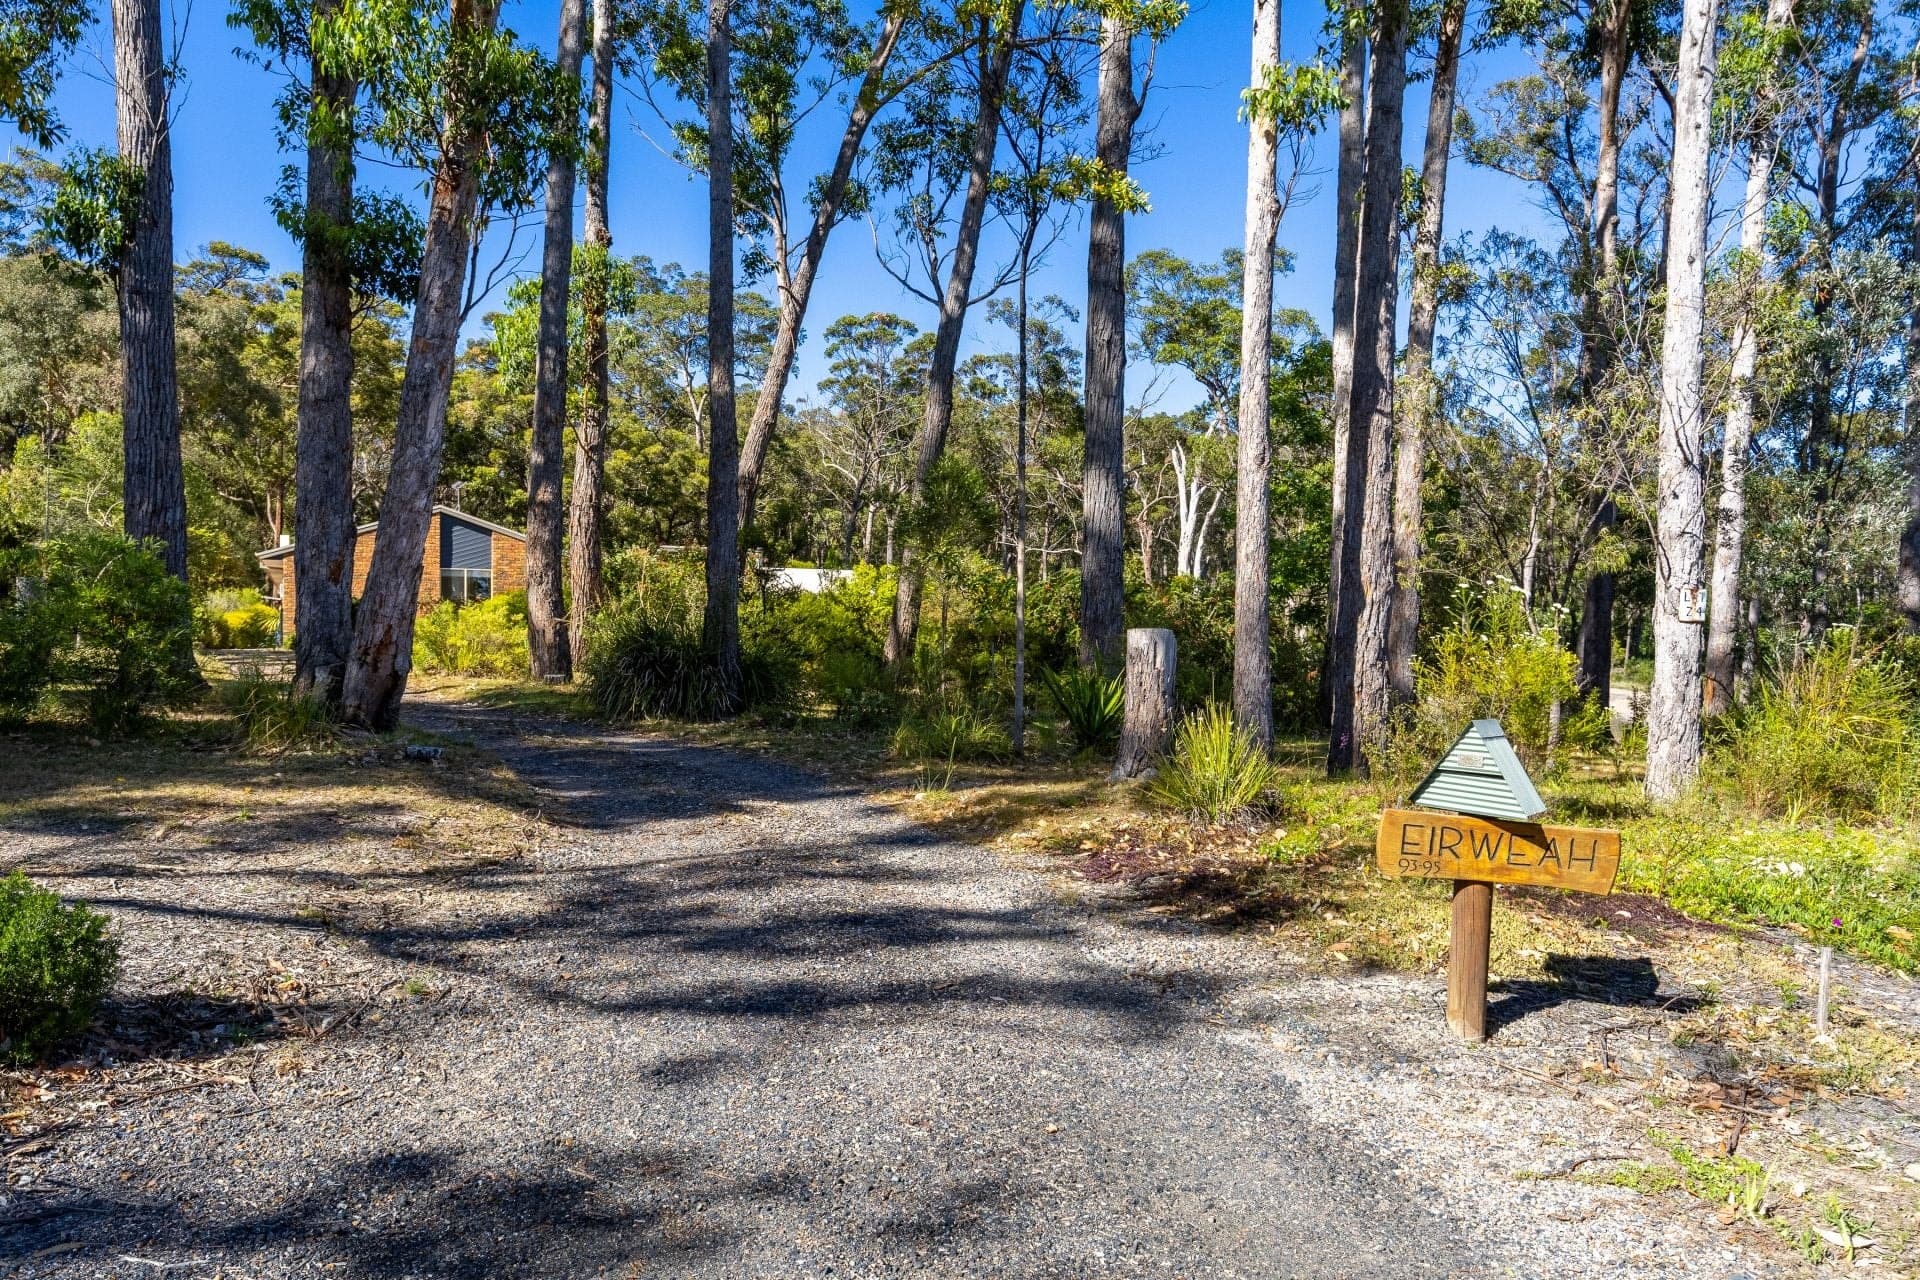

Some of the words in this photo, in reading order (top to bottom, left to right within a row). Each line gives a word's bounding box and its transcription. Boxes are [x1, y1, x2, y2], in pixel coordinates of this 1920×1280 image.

[1684, 591, 1705, 602] LT
[1400, 823, 1598, 872] EIRWEAH
[1398, 858, 1441, 876] 93-95
